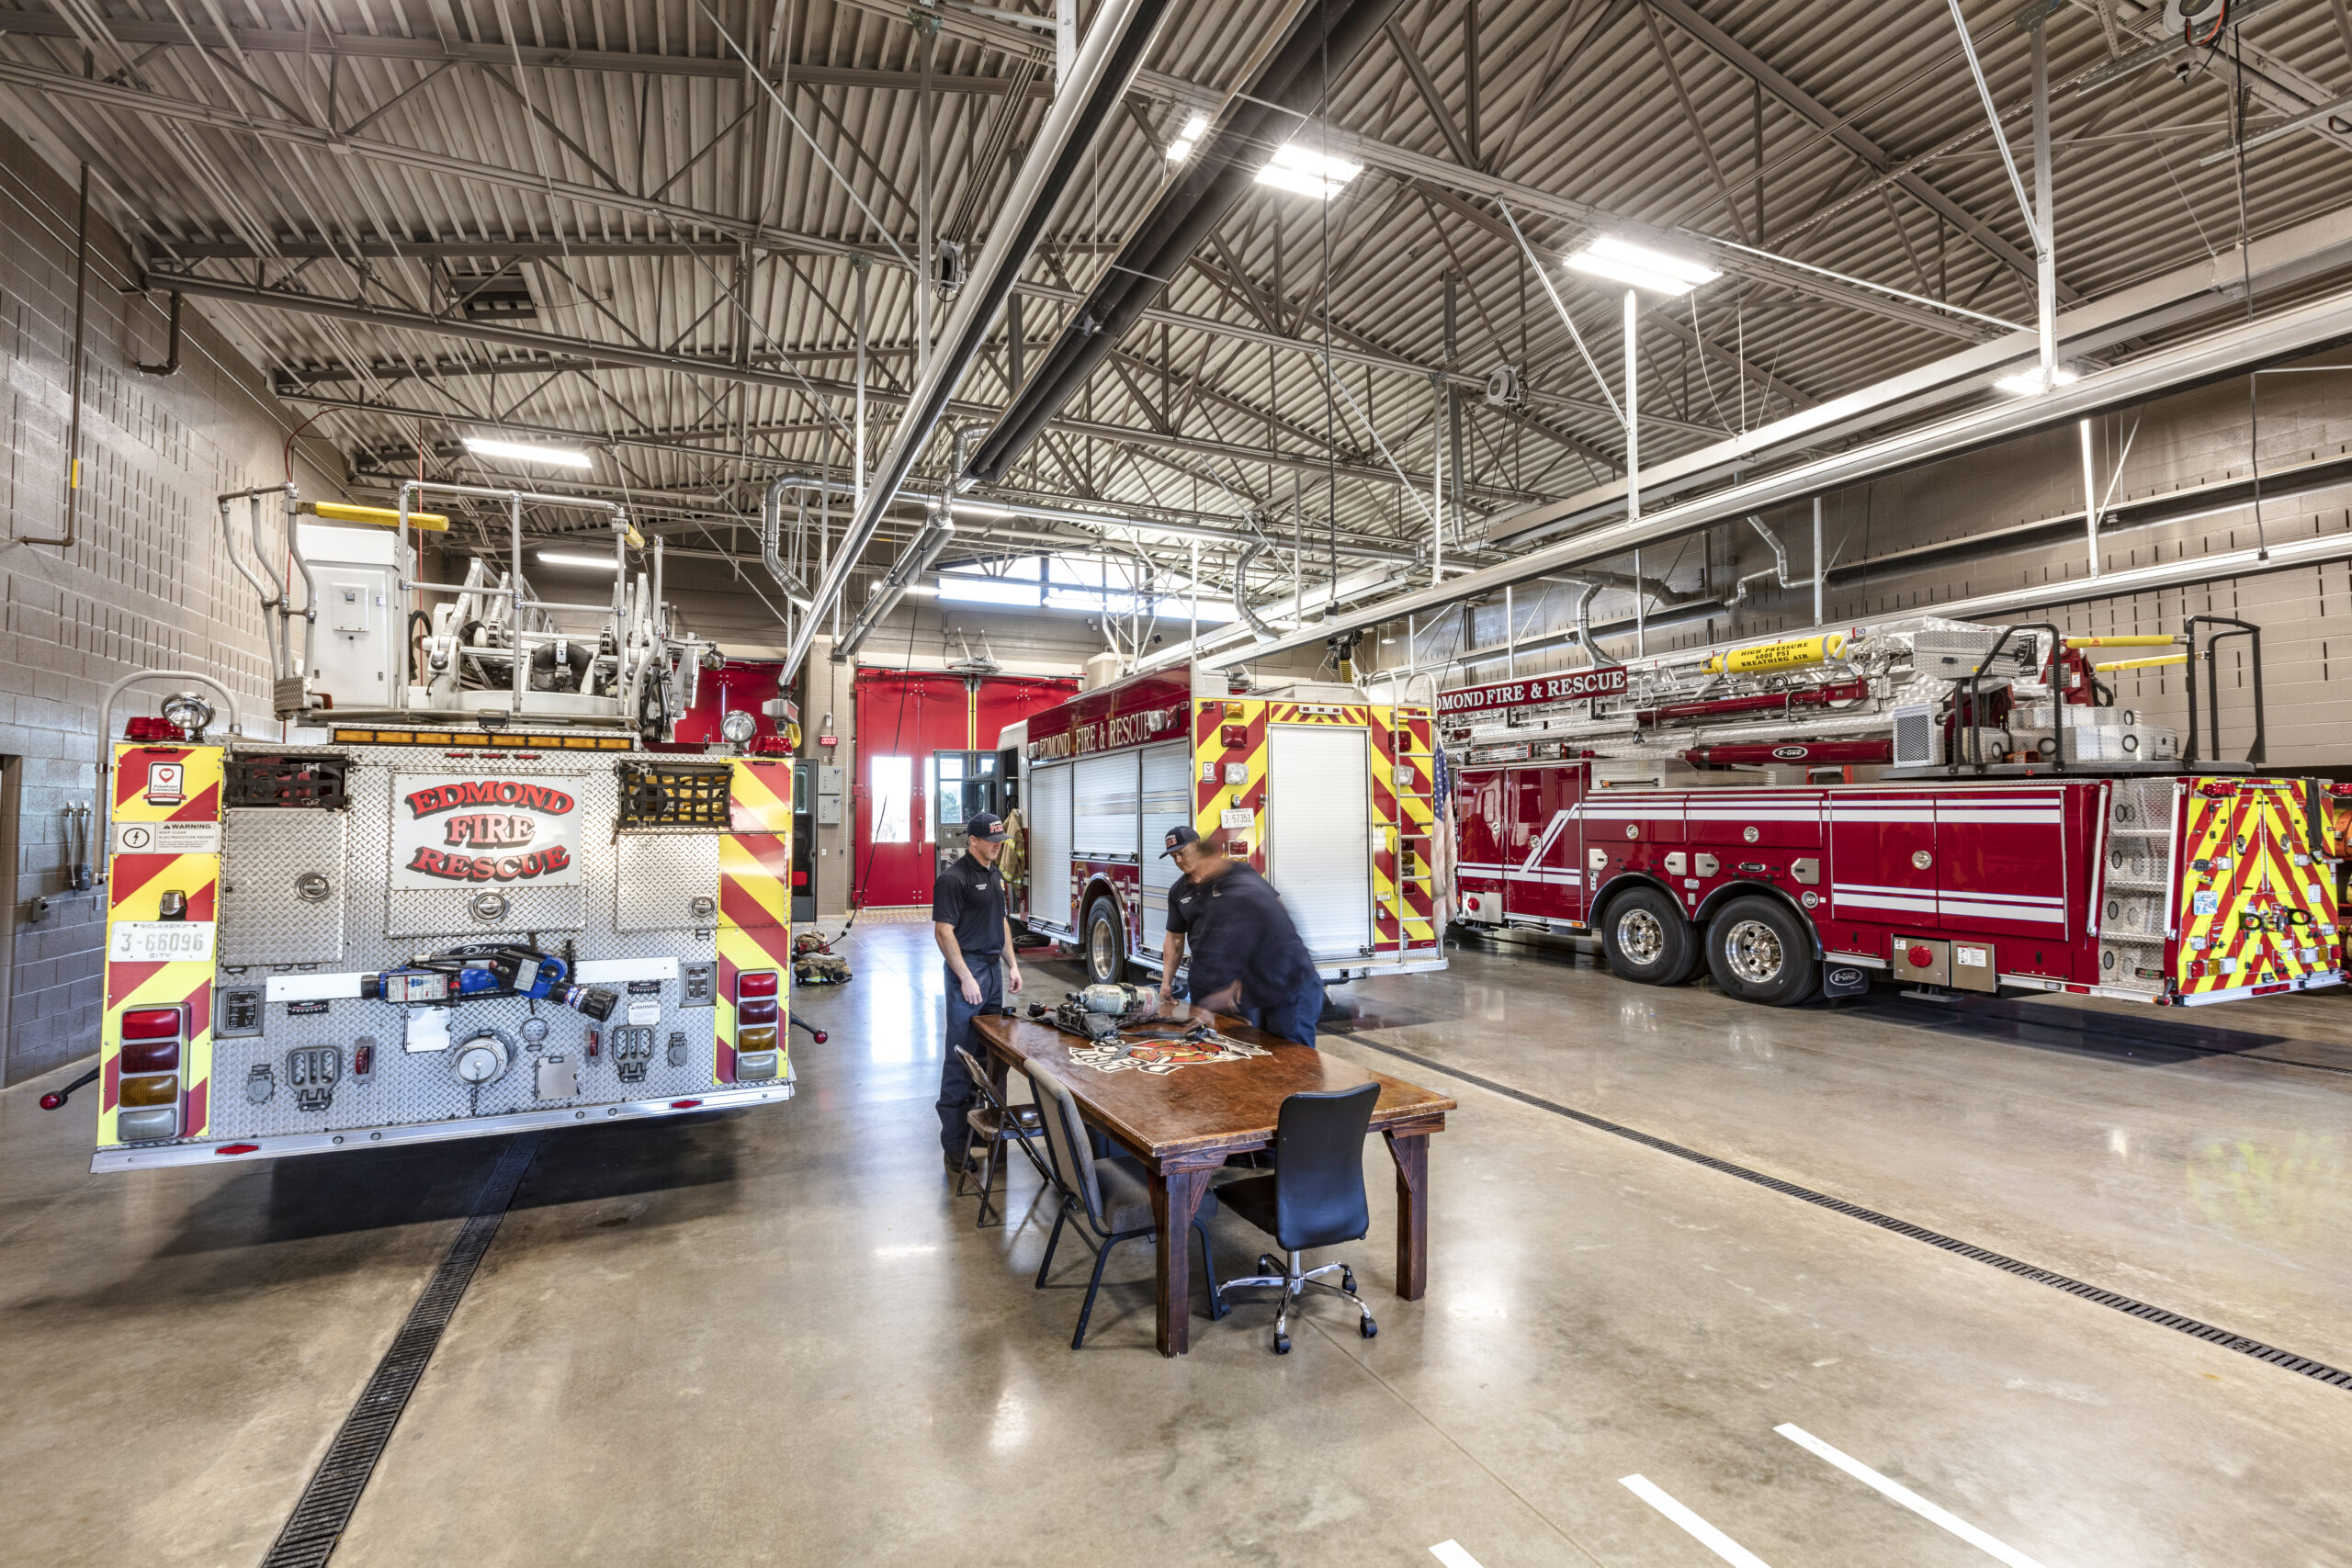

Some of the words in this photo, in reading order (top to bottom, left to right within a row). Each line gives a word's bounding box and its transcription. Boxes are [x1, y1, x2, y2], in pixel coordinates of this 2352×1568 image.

[1855, 627, 1866, 636] 50
[1740, 649, 1762, 657] HIGH
[1764, 642, 1809, 652] PRESSURE
[1741, 656, 1790, 667] BREATHING
[1755, 652, 1773, 660] 6000
[1436, 691, 1485, 711] DMOND
[1486, 684, 1525, 705] FIRE
[1530, 682, 1544, 700] &
[1546, 670, 1626, 697] RESCUE
[1039, 732, 1070, 761] EDMOND
[1076, 725, 1096, 754] FIRE
[1099, 722, 1106, 750] &
[1109, 710, 1151, 748] RESCUE
[404, 781, 574, 820] EDMOND
[444, 814, 536, 849] FIRE
[405, 844, 571, 883] RESCUE
[120, 932, 203, 952] 3-66096
